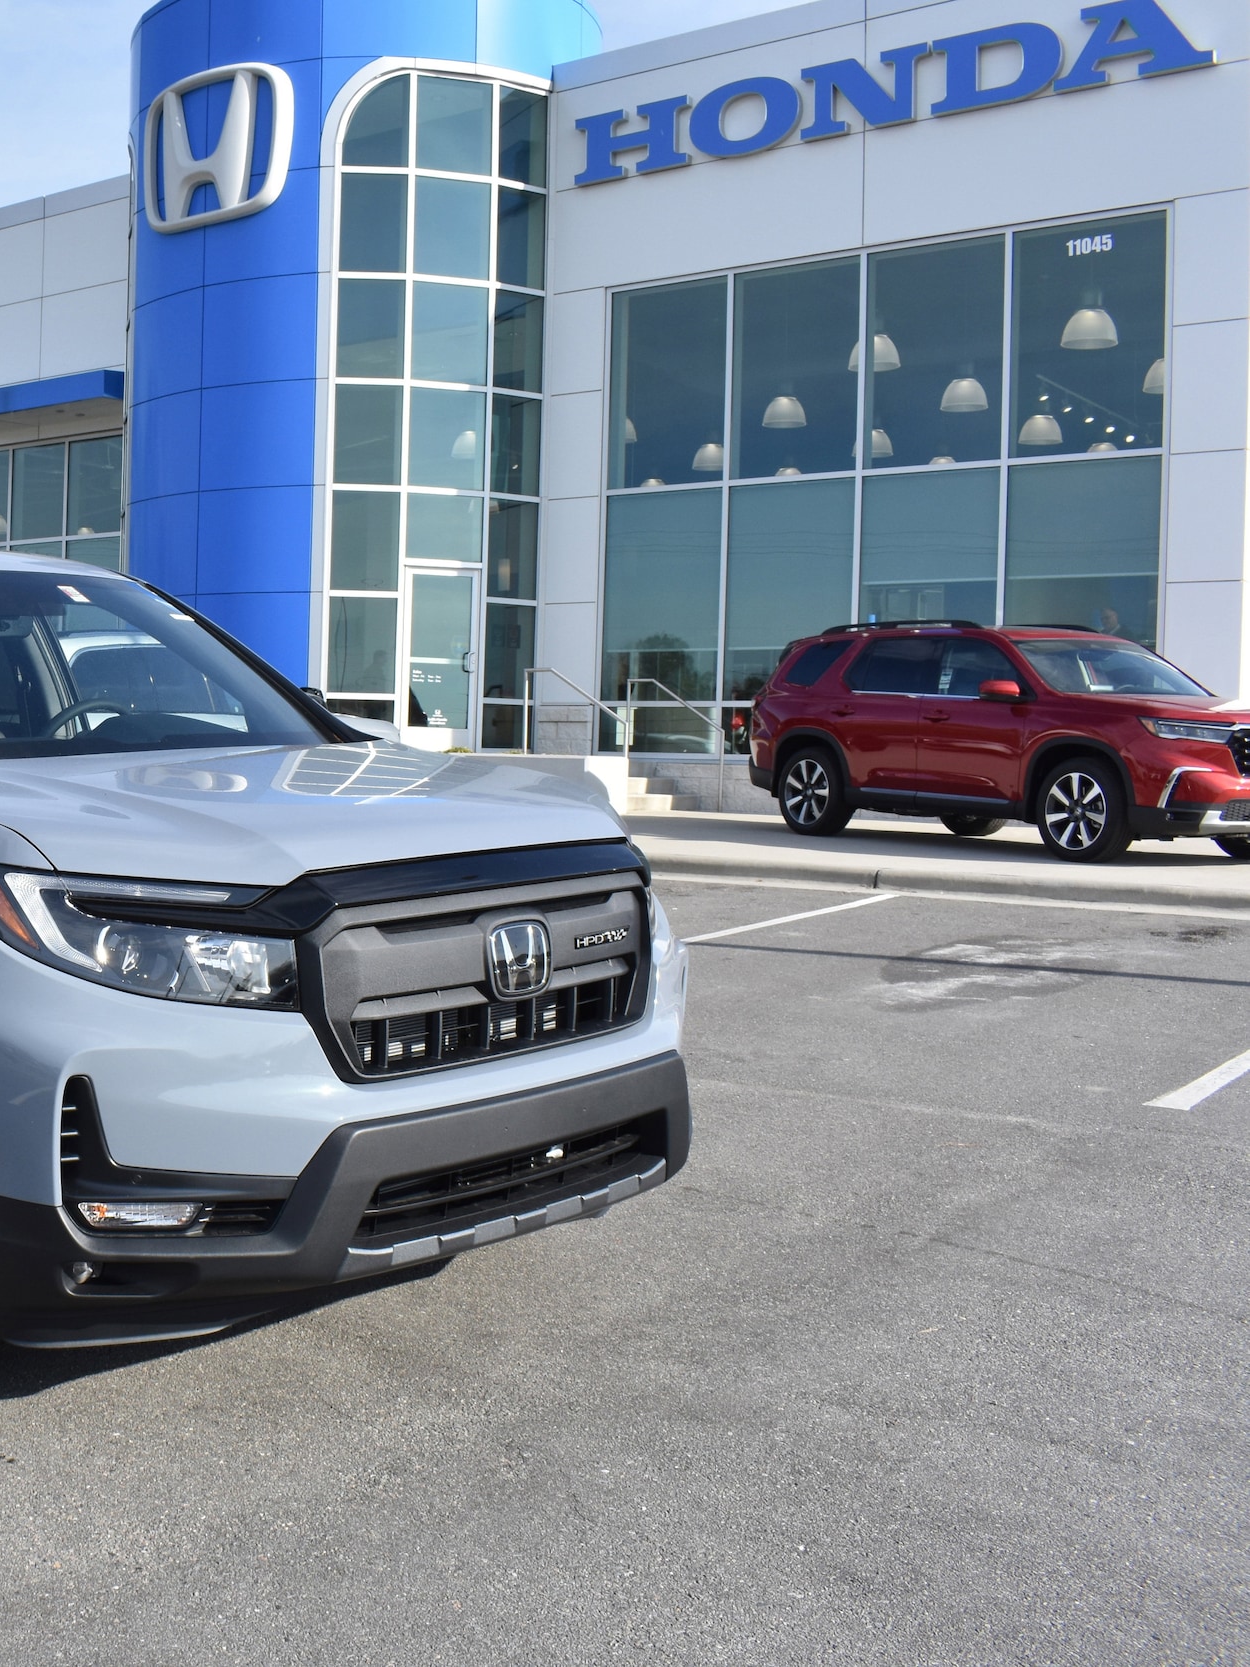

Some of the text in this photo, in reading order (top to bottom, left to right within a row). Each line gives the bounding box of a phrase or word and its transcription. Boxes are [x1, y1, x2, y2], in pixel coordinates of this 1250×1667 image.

[574, 0, 1217, 187] HONDA
[1066, 234, 1113, 257] 11045
[576, 934, 604, 948] HPD
